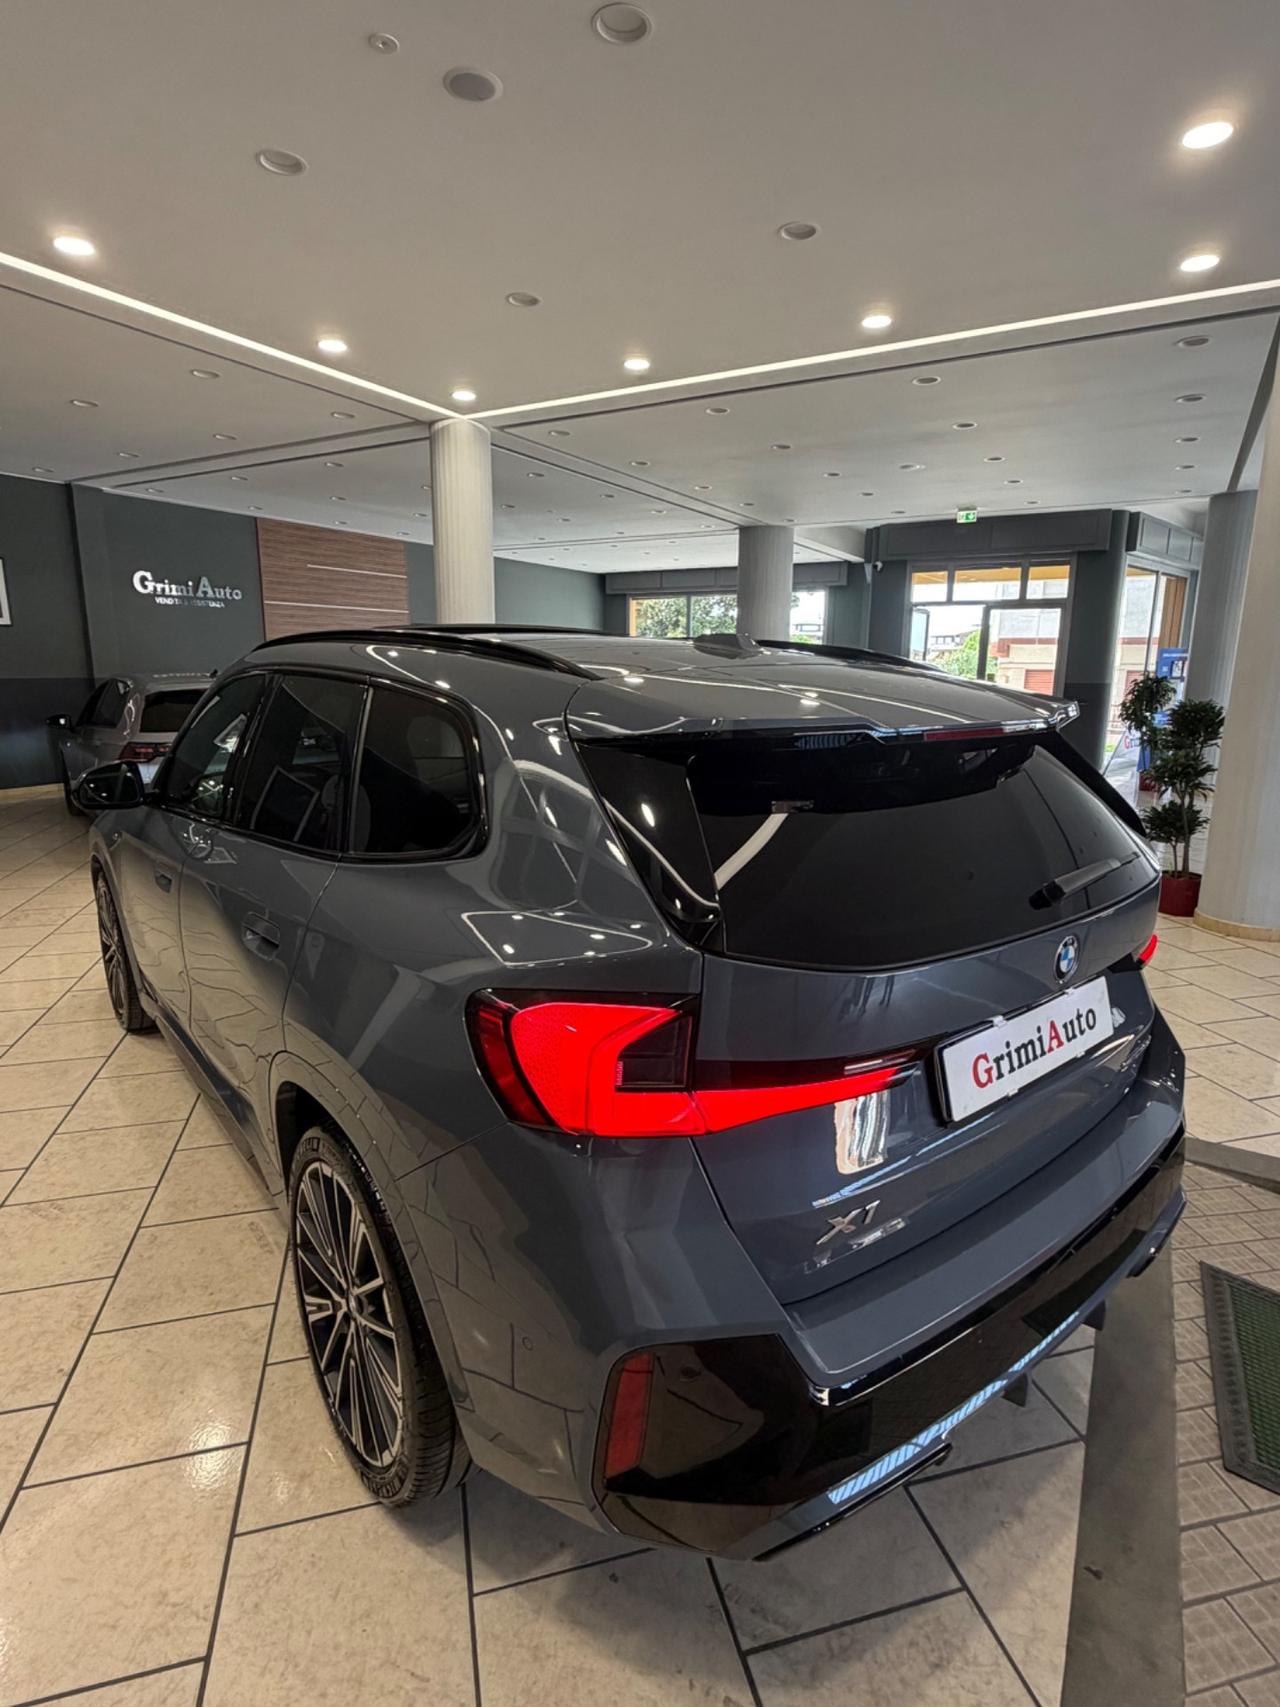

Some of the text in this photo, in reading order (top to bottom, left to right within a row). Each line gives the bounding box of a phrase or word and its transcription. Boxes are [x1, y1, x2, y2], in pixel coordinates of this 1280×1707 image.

[132, 570, 242, 600] Grimi Auto
[972, 1008, 1097, 1089] GrimiAuto
[816, 1199, 881, 1245] X1
